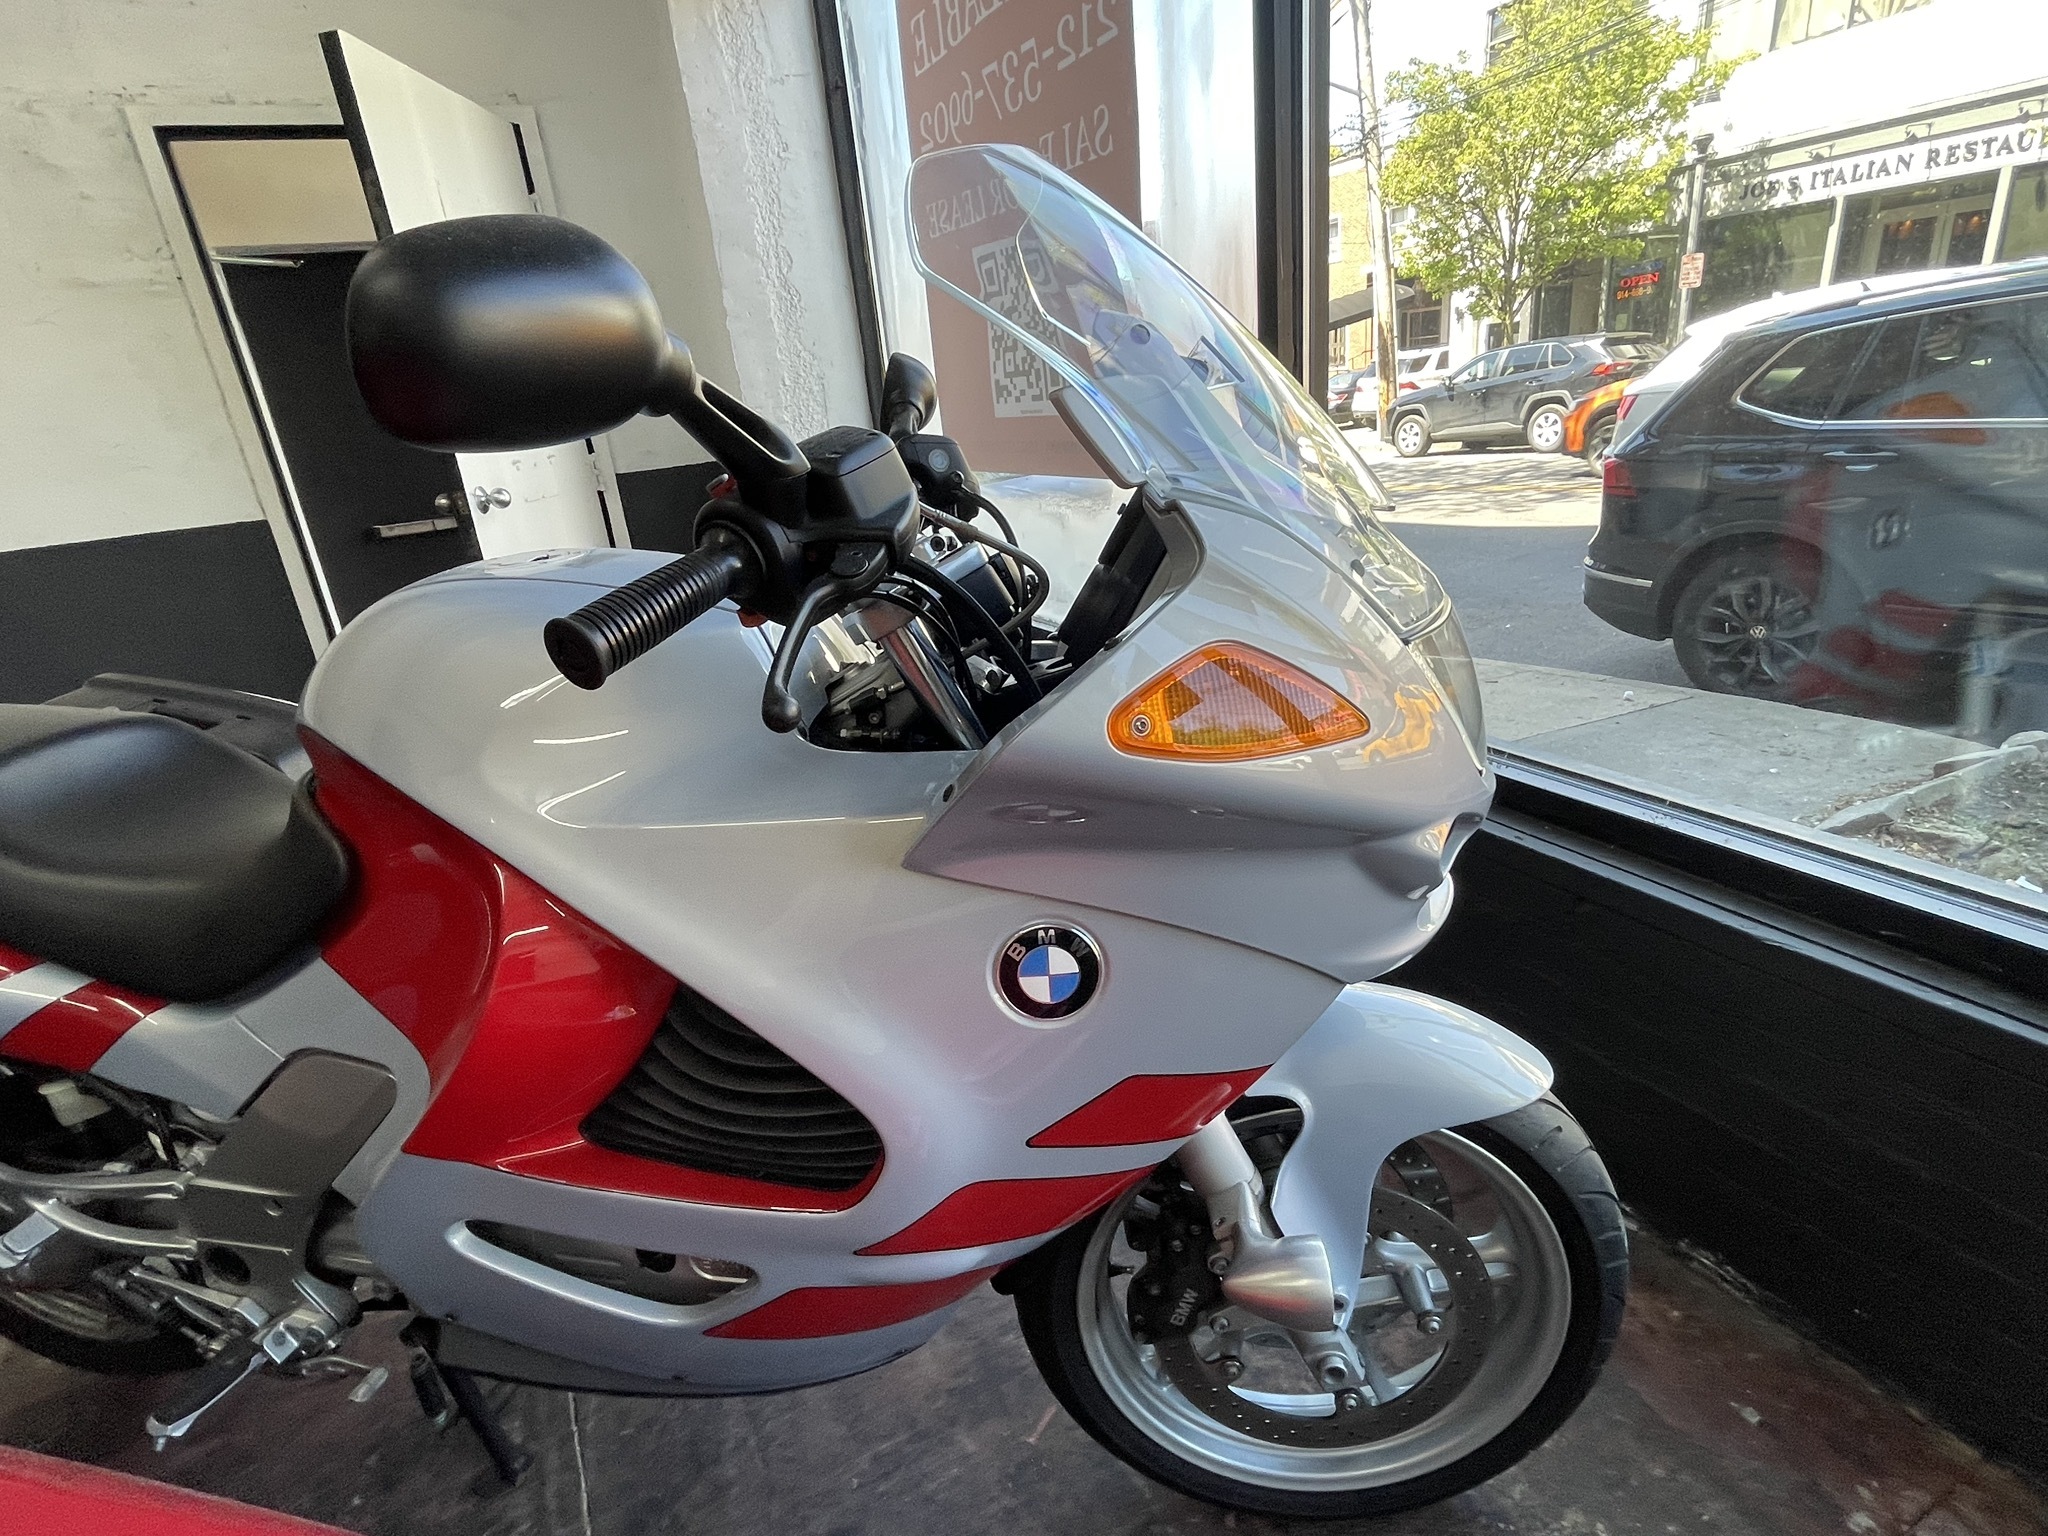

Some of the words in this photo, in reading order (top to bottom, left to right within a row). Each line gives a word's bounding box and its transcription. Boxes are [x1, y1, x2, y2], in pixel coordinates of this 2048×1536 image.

[1810, 153, 1914, 190] ITALIAN
[1620, 272, 1660, 288] OPEN
[1007, 929, 1089, 962] BMW
[1169, 1287, 1200, 1327] BMW
